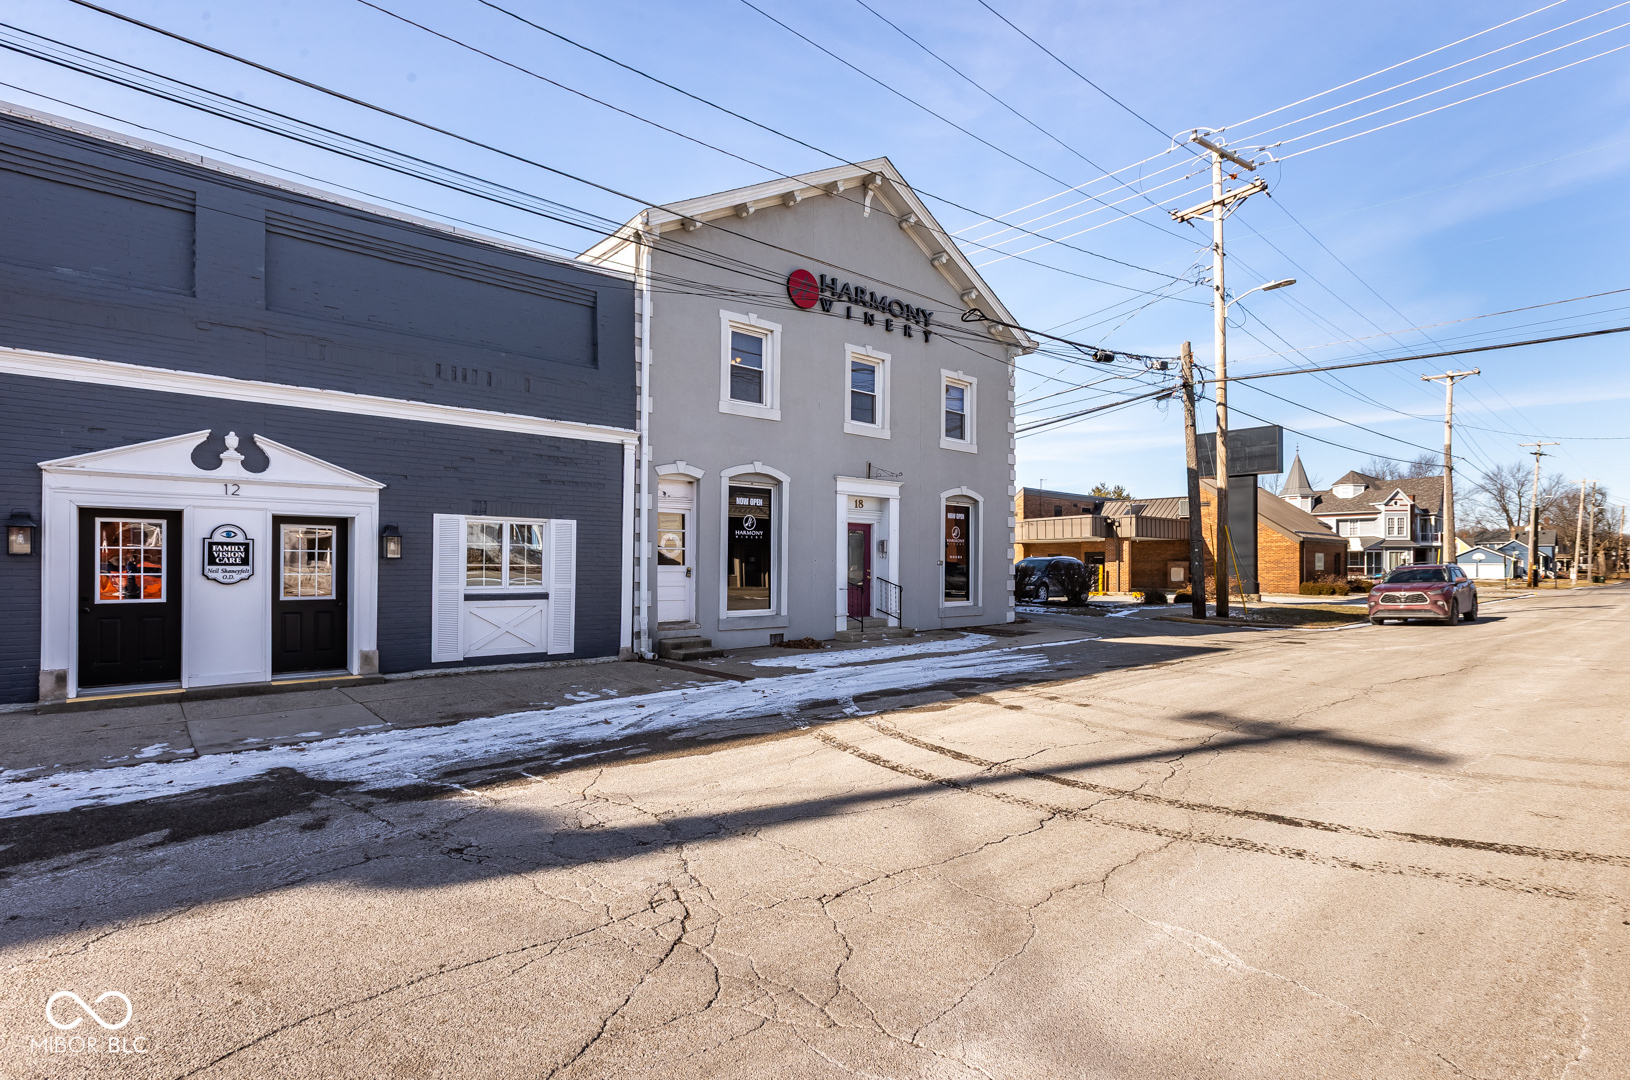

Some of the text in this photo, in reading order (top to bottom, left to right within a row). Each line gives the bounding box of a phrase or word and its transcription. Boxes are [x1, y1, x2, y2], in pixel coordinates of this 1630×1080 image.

[820, 274, 934, 327] HARMONY
[820, 298, 932, 343] WINERY
[224, 483, 240, 496] 12
[736, 497, 763, 506] NOW OPEN
[854, 499, 864, 508] 18
